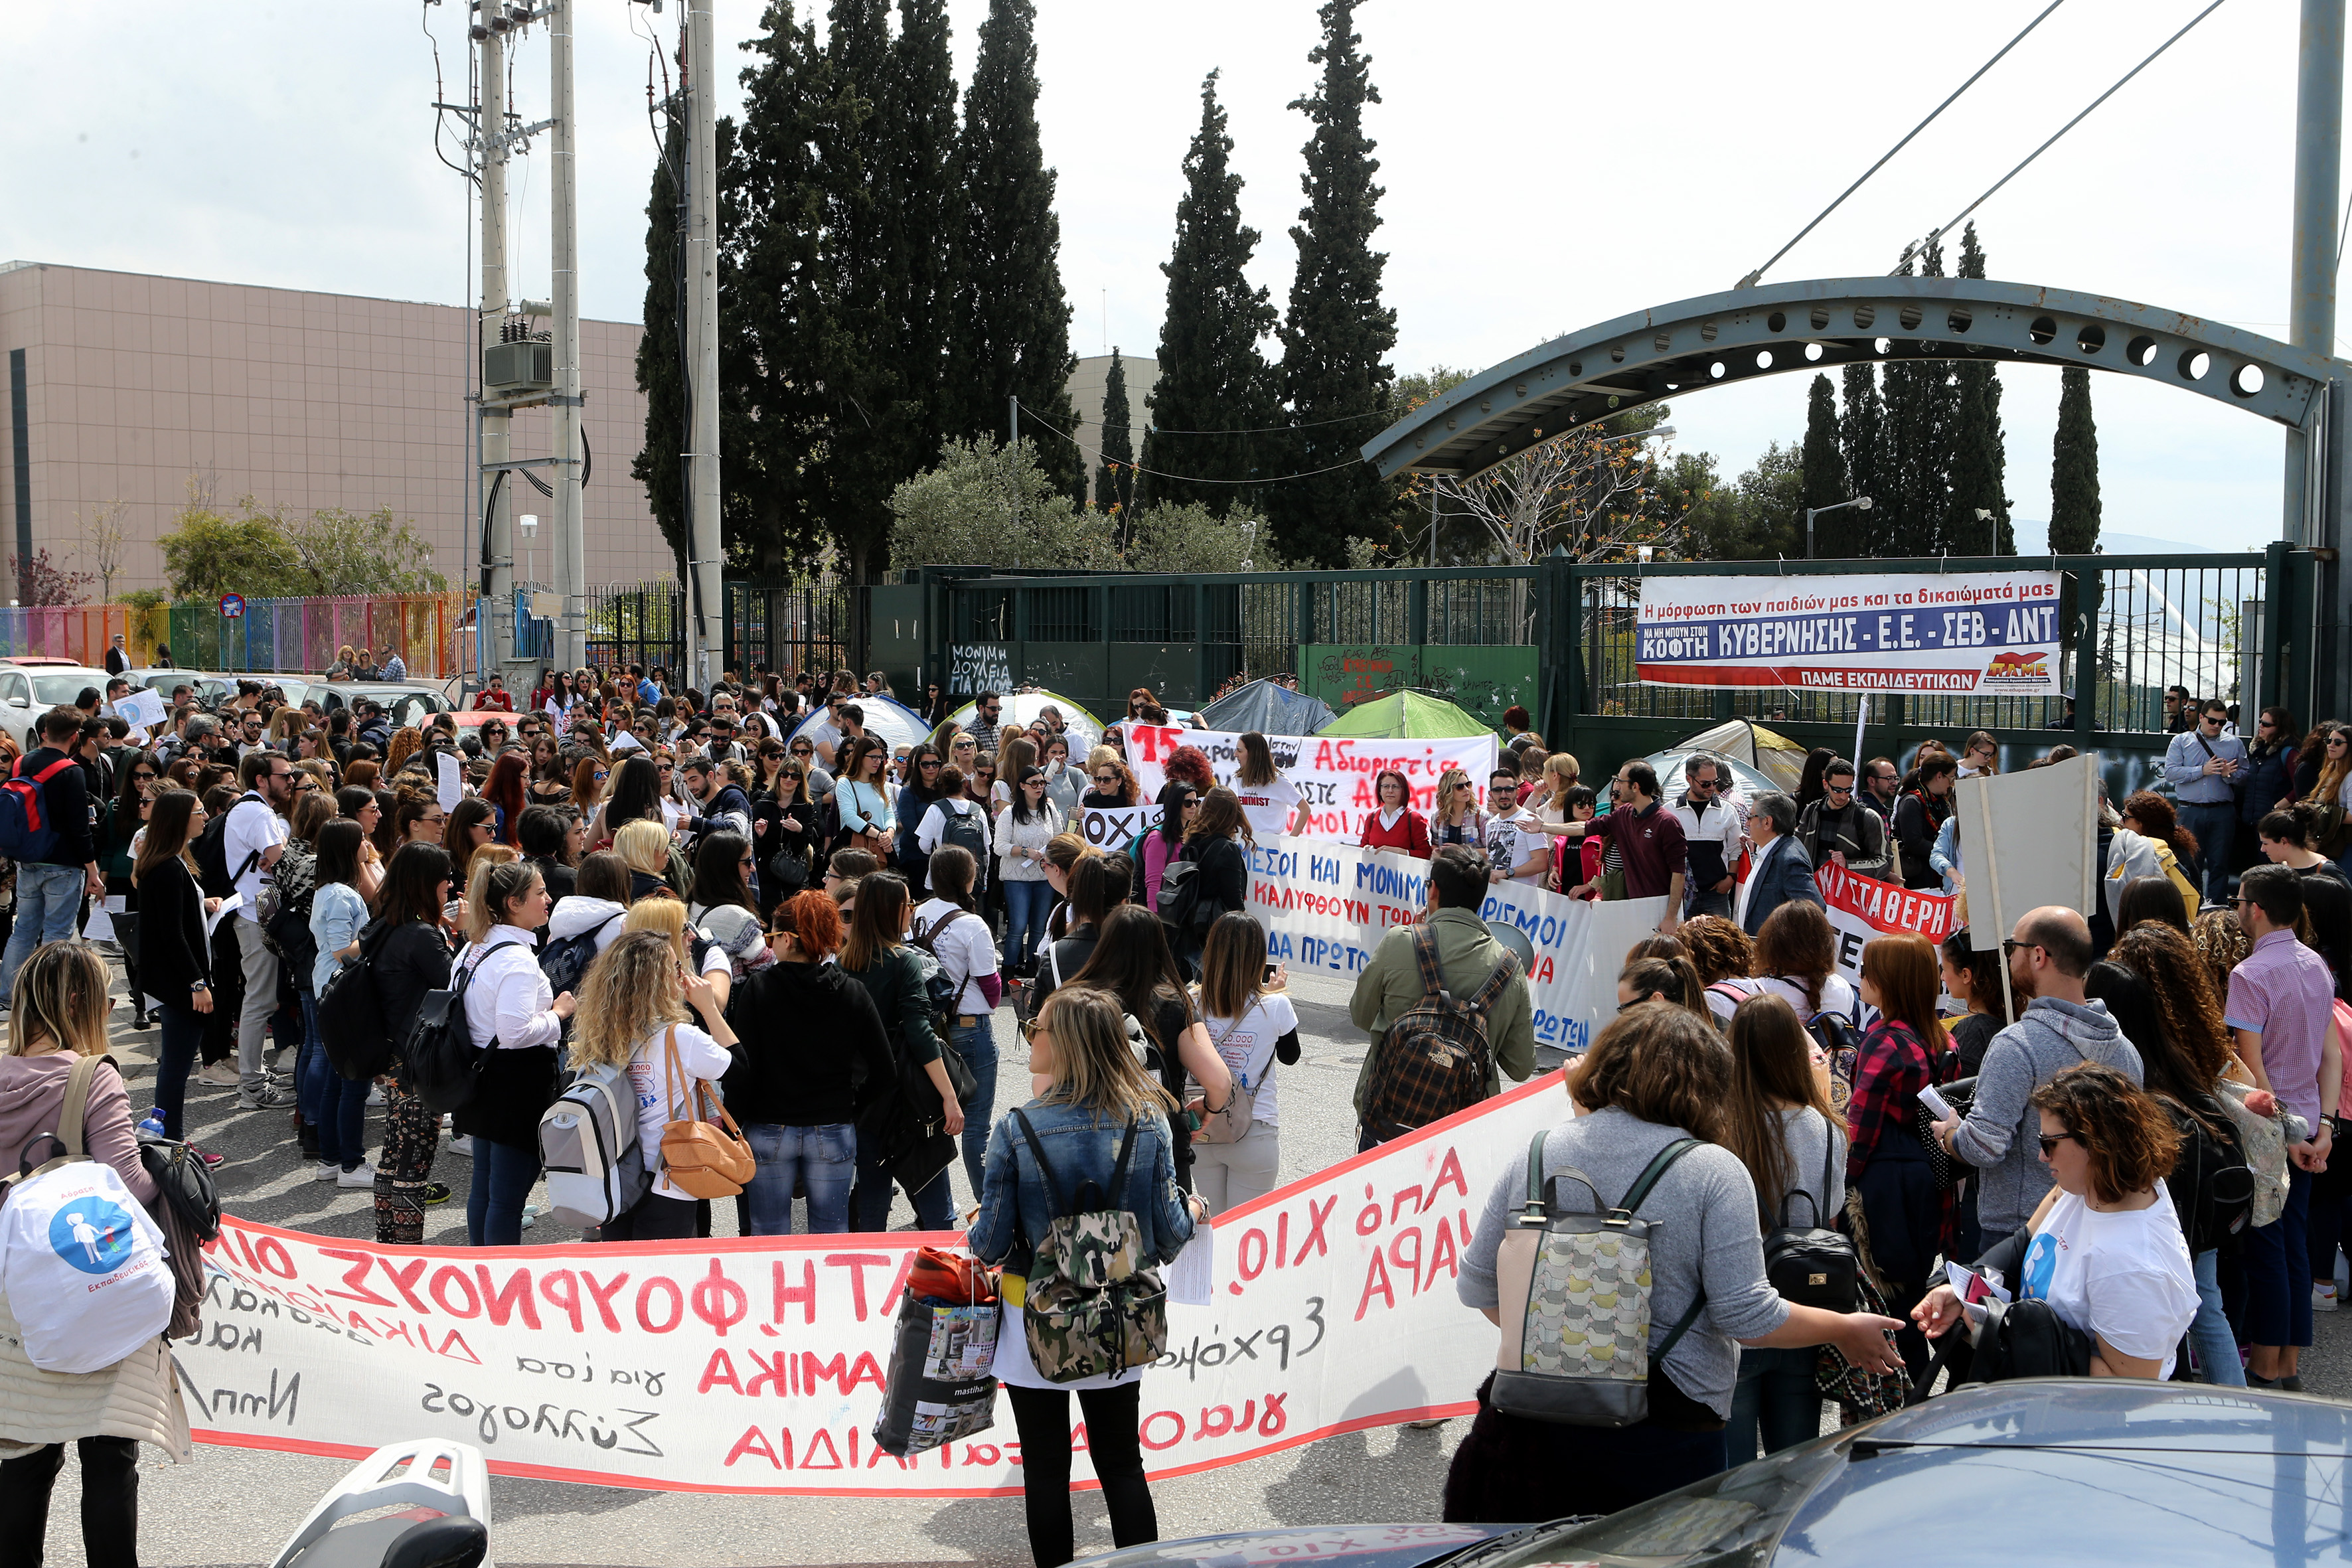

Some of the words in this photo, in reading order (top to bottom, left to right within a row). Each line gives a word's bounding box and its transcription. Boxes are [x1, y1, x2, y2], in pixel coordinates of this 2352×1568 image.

[1644, 603, 1654, 618] Η
[1657, 601, 1726, 621] μόρφωση
[1730, 602, 1761, 615] των
[1766, 594, 1826, 613] παιδιών
[1830, 595, 1858, 612] μας
[1863, 595, 1889, 606] και
[1894, 593, 1913, 605] τα
[1918, 582, 2013, 605] δικαιώματά
[2019, 584, 2055, 601] μας
[1644, 627, 1653, 639] ΝΑ
[1654, 627, 1664, 638] ΜΗ
[1665, 626, 1689, 637] ΜΠΟΥΝ
[1689, 625, 1708, 637] ΣΤΟΝ
[1718, 616, 1857, 657] ΚΥΒΕΡΝΗΣΗΣ
[1878, 613, 1921, 650] Ε.Ε.
[1942, 610, 1987, 647] ΣΕΒ
[2005, 606, 2055, 644] ΔΝΤ
[952, 645, 1006, 662] ΜΟΝΙΜΗ
[1642, 637, 1709, 659] ΚΟΦΤΗ
[951, 660, 1010, 679] ΔΟΥΛΕΙΑ
[1800, 669, 1844, 687] ΠΑΜΕ
[1847, 671, 1974, 690] ΕΚΠΑΙΔΕΥΤΙΚΩΝ
[1988, 663, 2049, 677] ΠΑΜΕ
[949, 675, 972, 694] ΓΙΑ
[1132, 726, 1183, 765] 15
[1238, 795, 1270, 807] EMINIST
[1085, 811, 1146, 846] ΟΧΙ
[1237, 843, 1298, 879] ΜΕΣΟΙ
[1310, 854, 1340, 886] ΚΑΙ
[1477, 896, 1567, 949] ΡΙΣΜΟΙ
[1254, 880, 1370, 925] ΚΑΛΥΦΘΟΥΝ
[1848, 876, 1947, 935] ΣΤΑΘΕΡΗ
[1267, 931, 1293, 960] ΔΑ
[60, 1186, 95, 1200] Αόρατη
[87, 1259, 149, 1293] Εκπαιδευτικός
